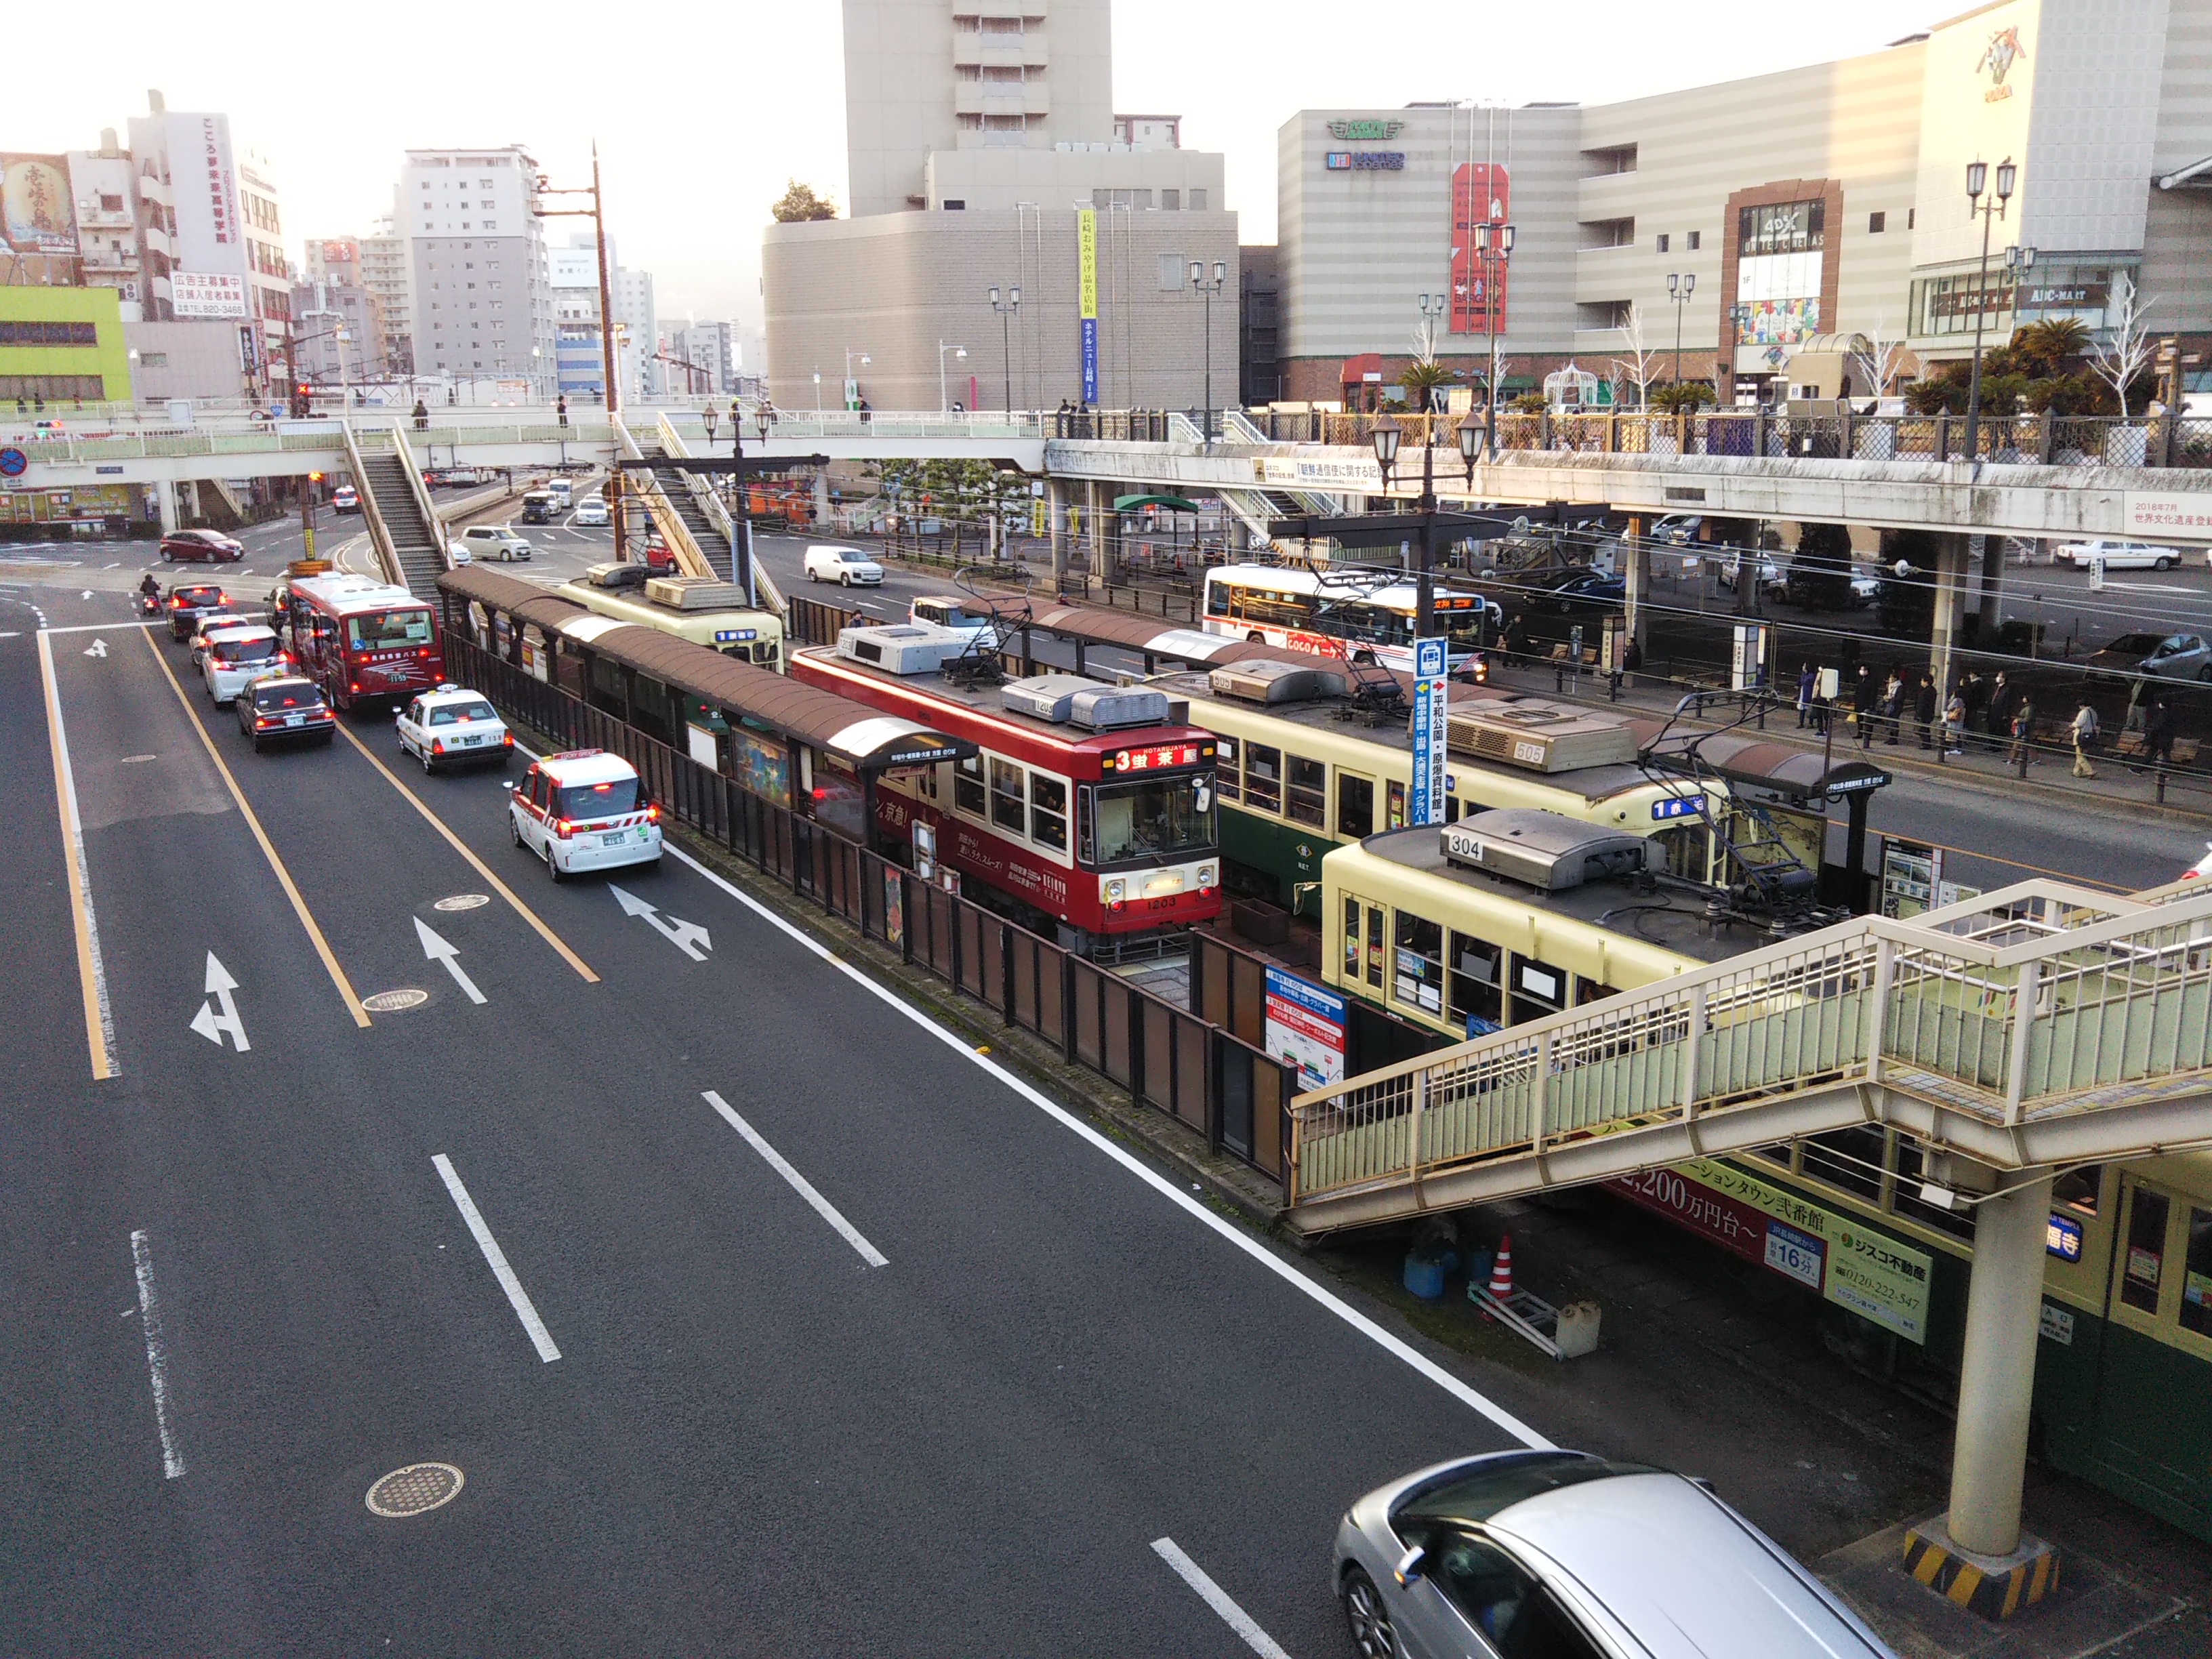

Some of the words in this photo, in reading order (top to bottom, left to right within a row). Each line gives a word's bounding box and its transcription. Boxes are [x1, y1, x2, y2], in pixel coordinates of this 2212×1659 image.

[1082, 213, 1092, 314] 長崎おみやげ品名店街
[175, 275, 240, 287] 広告主募集中
[2135, 503, 2177, 512] 2018年7月
[1214, 676, 1231, 688] 505
[561, 752, 578, 760] LUCKY
[1143, 744, 1187, 754] HOTARUJAYA
[1517, 743, 1541, 762] 505
[1116, 751, 1130, 771] 3
[1132, 748, 1197, 769] 蛍茶屋
[1654, 801, 1666, 818] 1
[1452, 835, 1479, 859] 304
[1148, 897, 1176, 911] 1203
[2058, 1216, 2081, 1231] TEMPLE
[1778, 1244, 1800, 1269] 16
[1801, 1262, 1814, 1275] 分
[1854, 1238, 1927, 1283] ジスコ不動産
[1845, 1269, 1920, 1310] 0120-222-547
